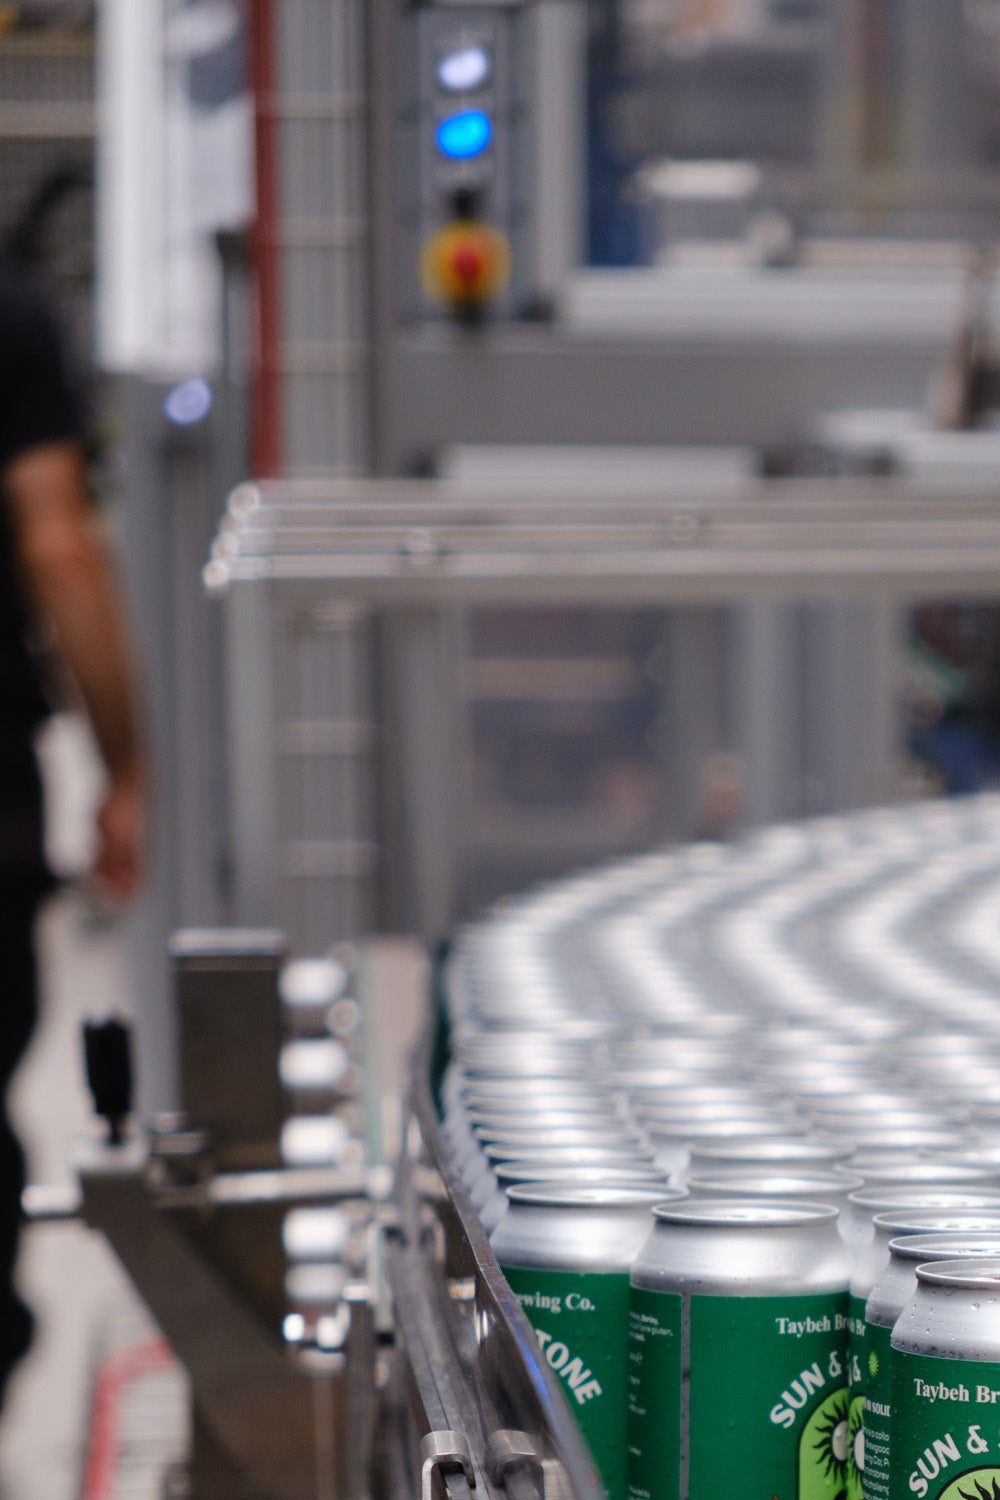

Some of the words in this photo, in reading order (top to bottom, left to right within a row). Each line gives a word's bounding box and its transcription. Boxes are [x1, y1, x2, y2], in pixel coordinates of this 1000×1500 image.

[565, 1293, 595, 1311] Co.
[775, 1315, 831, 1338] Taybeh
[770, 1362, 826, 1429] SUN
[914, 1378, 969, 1403] Taybeh
[909, 1433, 962, 1498] SUN
[966, 1424, 989, 1454] &
